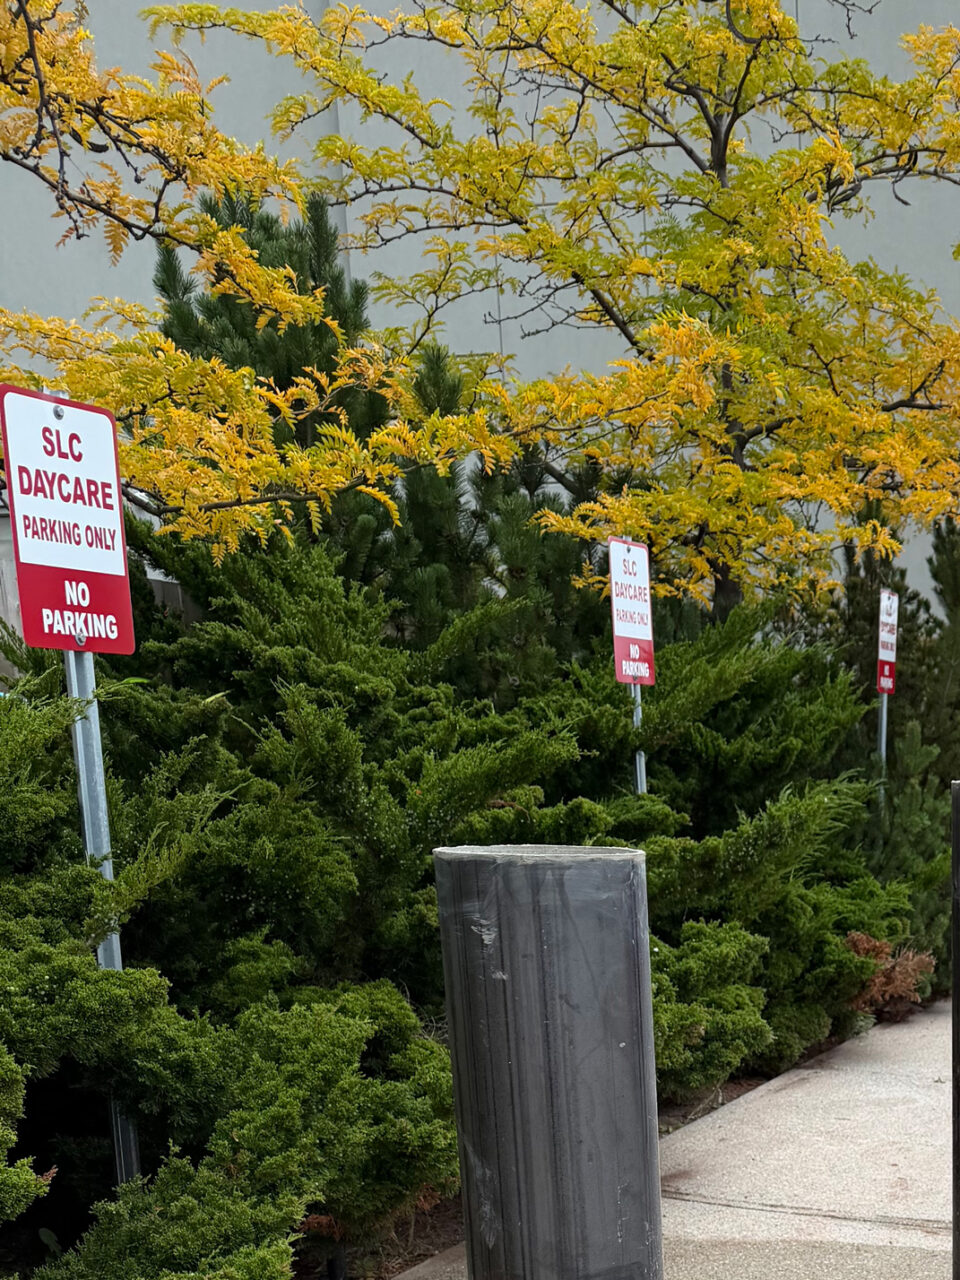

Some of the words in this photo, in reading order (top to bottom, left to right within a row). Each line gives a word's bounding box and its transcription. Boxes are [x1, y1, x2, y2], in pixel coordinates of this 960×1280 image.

[41, 426, 83, 463] SLC
[17, 465, 114, 511] DAYCARE
[22, 514, 82, 547] PARKING
[84, 525, 117, 551] ONLY
[622, 558, 637, 577] SLC
[64, 580, 90, 607] NO
[614, 581, 648, 603] DAYCARE
[42, 608, 118, 640] PARKING
[629, 643, 640, 660] NO
[622, 660, 649, 678] PARKING
